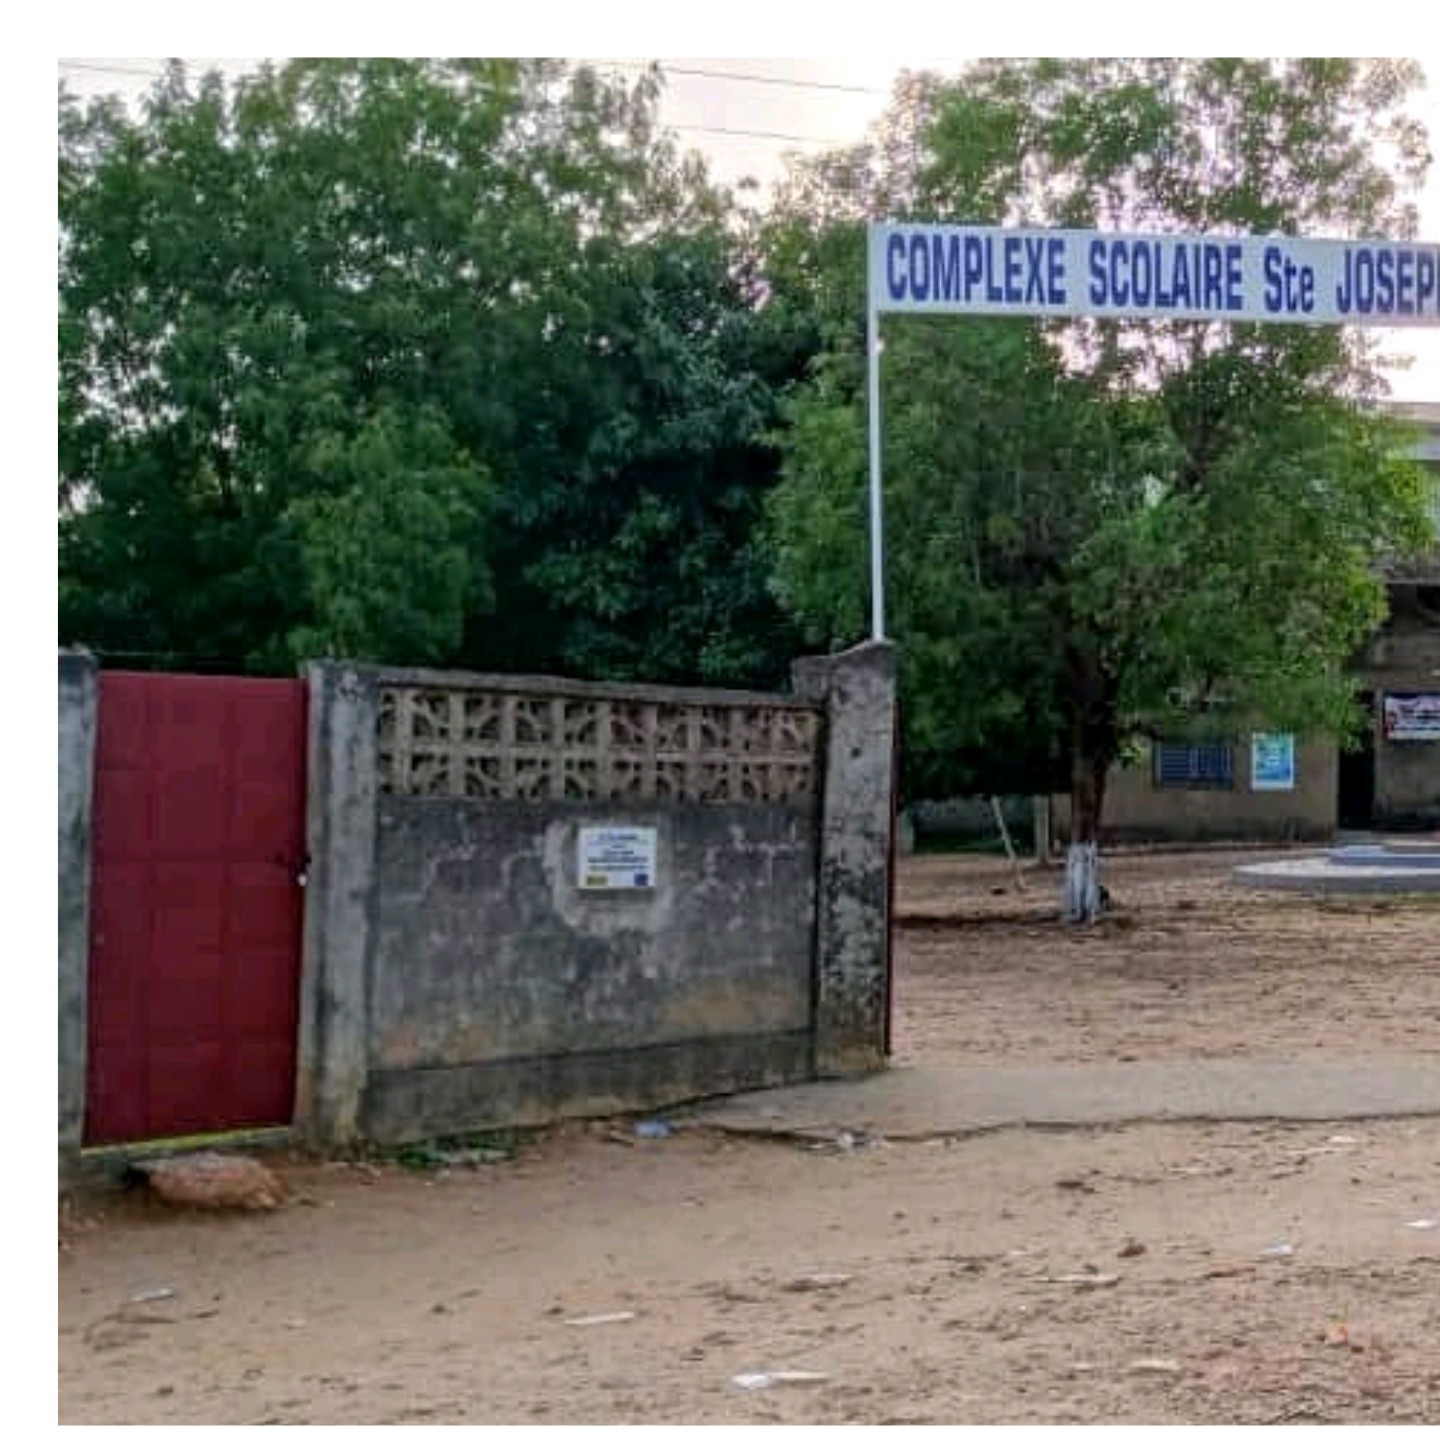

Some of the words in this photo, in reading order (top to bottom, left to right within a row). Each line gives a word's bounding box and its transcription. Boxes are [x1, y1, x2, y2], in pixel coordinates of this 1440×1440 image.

[887, 233, 1067, 305] COMPLEXE
[1088, 239, 1245, 311] SCOLAIRE
[1264, 245, 1315, 315] Ste
